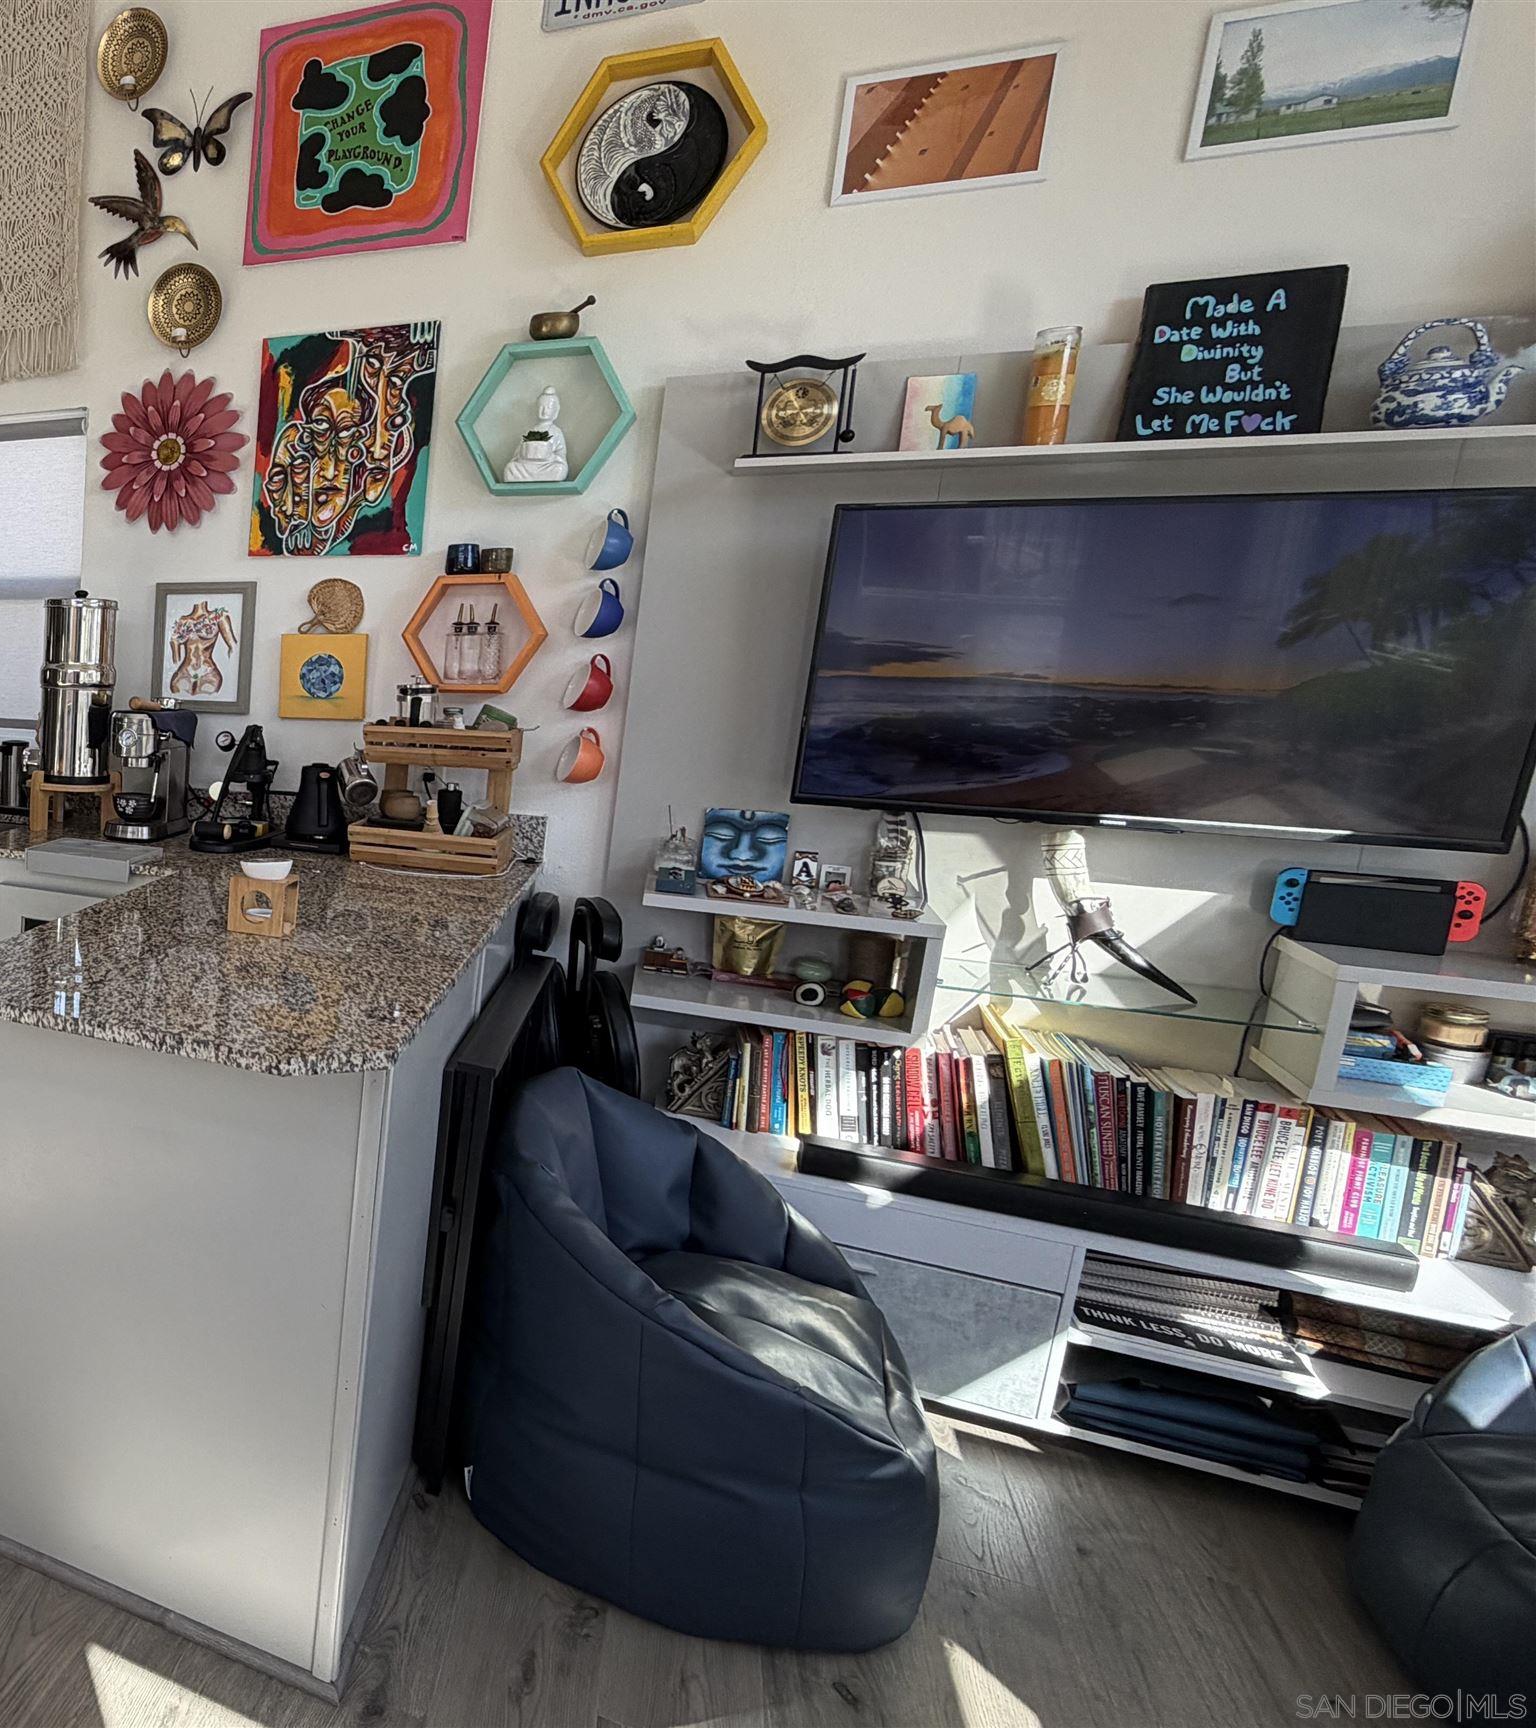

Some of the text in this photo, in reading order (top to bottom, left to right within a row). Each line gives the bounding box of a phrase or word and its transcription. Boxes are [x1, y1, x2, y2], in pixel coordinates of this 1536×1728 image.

[582, 2, 665, 20] dmv.ca.gov
[324, 98, 374, 132] CHANGE
[337, 121, 367, 142] YOUR
[327, 144, 404, 172] PLAYGROUND.
[1185, 288, 1287, 320] Made A
[1154, 319, 1261, 344] Date With
[1180, 342, 1264, 364] Divinity
[1224, 363, 1263, 384] But
[1152, 380, 1292, 405] She Wouldn't
[1135, 413, 1174, 436] Let
[1185, 412, 1220, 434] Me
[796, 861, 814, 878] A
[797, 1035, 805, 1065] SPEEDY
[798, 1066, 806, 1092] KNOTS
[823, 1069, 831, 1096] HERBAL
[907, 1055, 921, 1086] SHADOW
[908, 1086, 922, 1109] CELL
[1097, 1079, 1112, 1141] TUSCAN SUN
[1136, 1086, 1145, 1126] DAVE RAMSEY
[1153, 1116, 1162, 1148] NOTABLE
[1240, 1103, 1254, 1134] SAN DIEGO
[1250, 1118, 1269, 1160] BRUCE LEE
[1153, 1151, 1161, 1177] NATIVE
[1260, 1120, 1291, 1210] BRUCE LEE JEET KUNE DO
[1297, 1125, 1324, 1222] POET WARRIOR JOY HARJO
[1350, 1137, 1369, 1208] FEMINIST FIGHT CLUB
[1079, 1306, 1295, 1364] THINK LESS. DO MORE.
